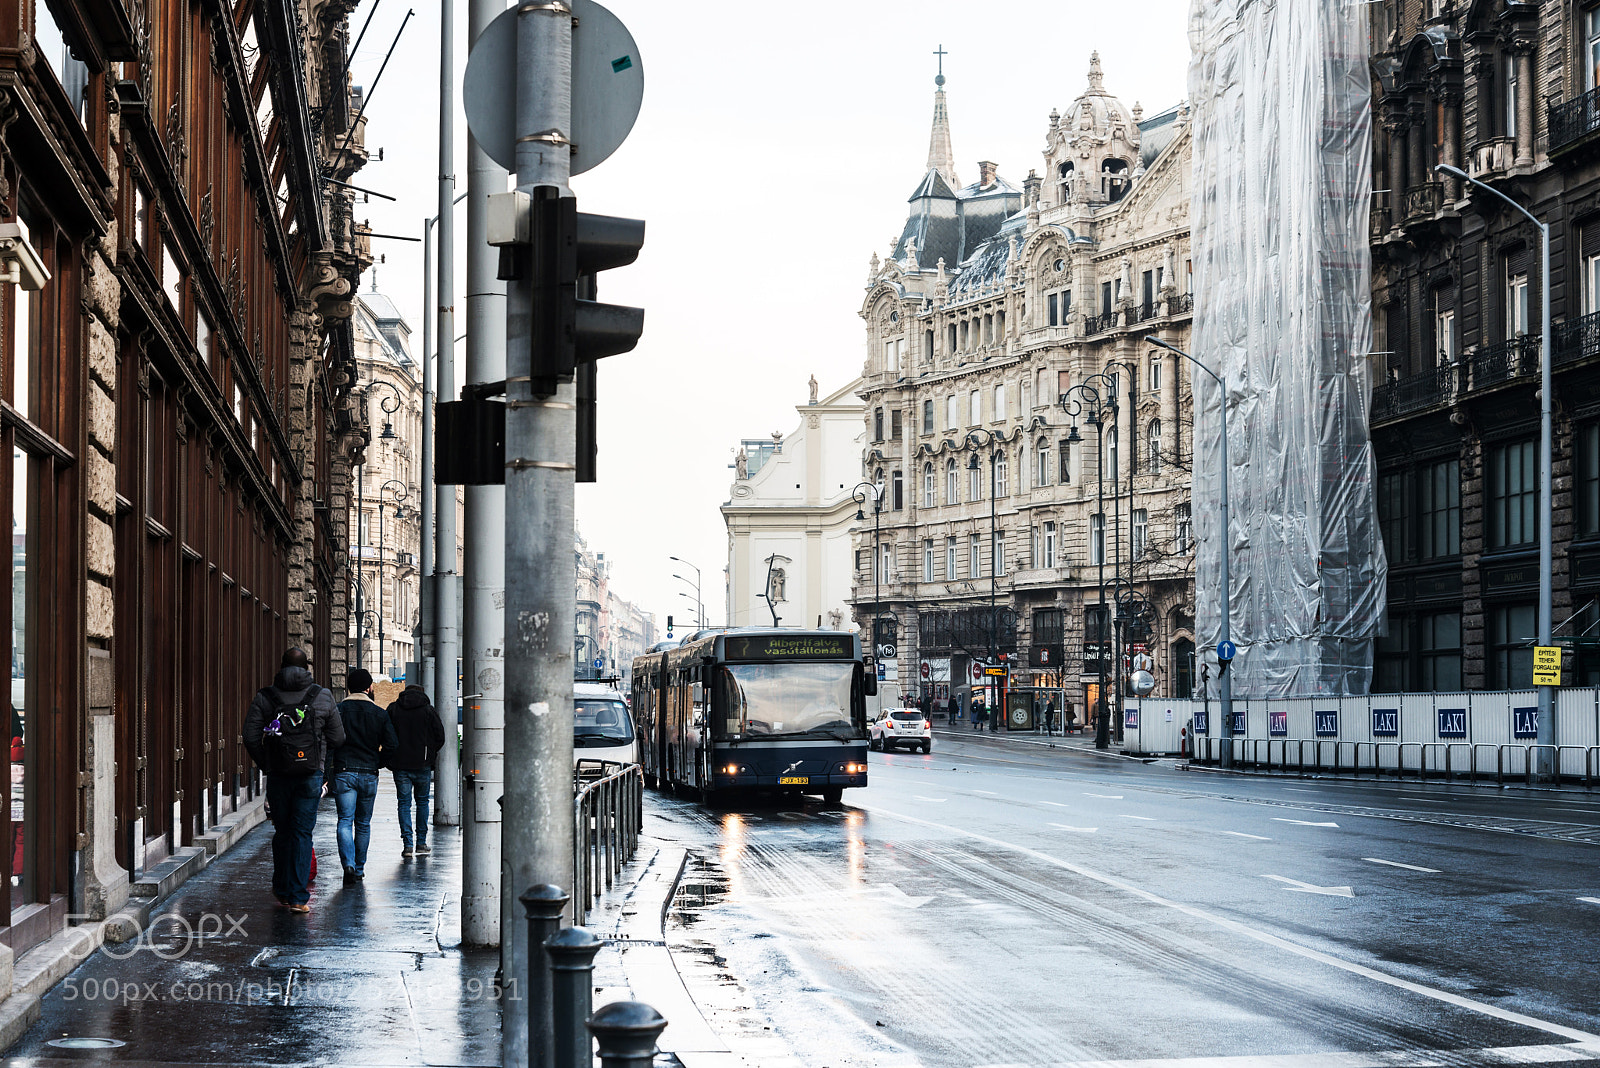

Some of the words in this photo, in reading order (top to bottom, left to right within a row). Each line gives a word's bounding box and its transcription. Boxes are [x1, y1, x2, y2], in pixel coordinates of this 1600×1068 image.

[740, 640, 750, 656] 7
[1195, 715, 1206, 730] LAK
[1234, 715, 1245, 731] AKI
[1270, 715, 1286, 731] LAKI
[1316, 715, 1336, 732] LAKI
[1374, 713, 1396, 732] LAKI
[1439, 713, 1465, 733] LAKI
[1516, 712, 1539, 733] LAK
